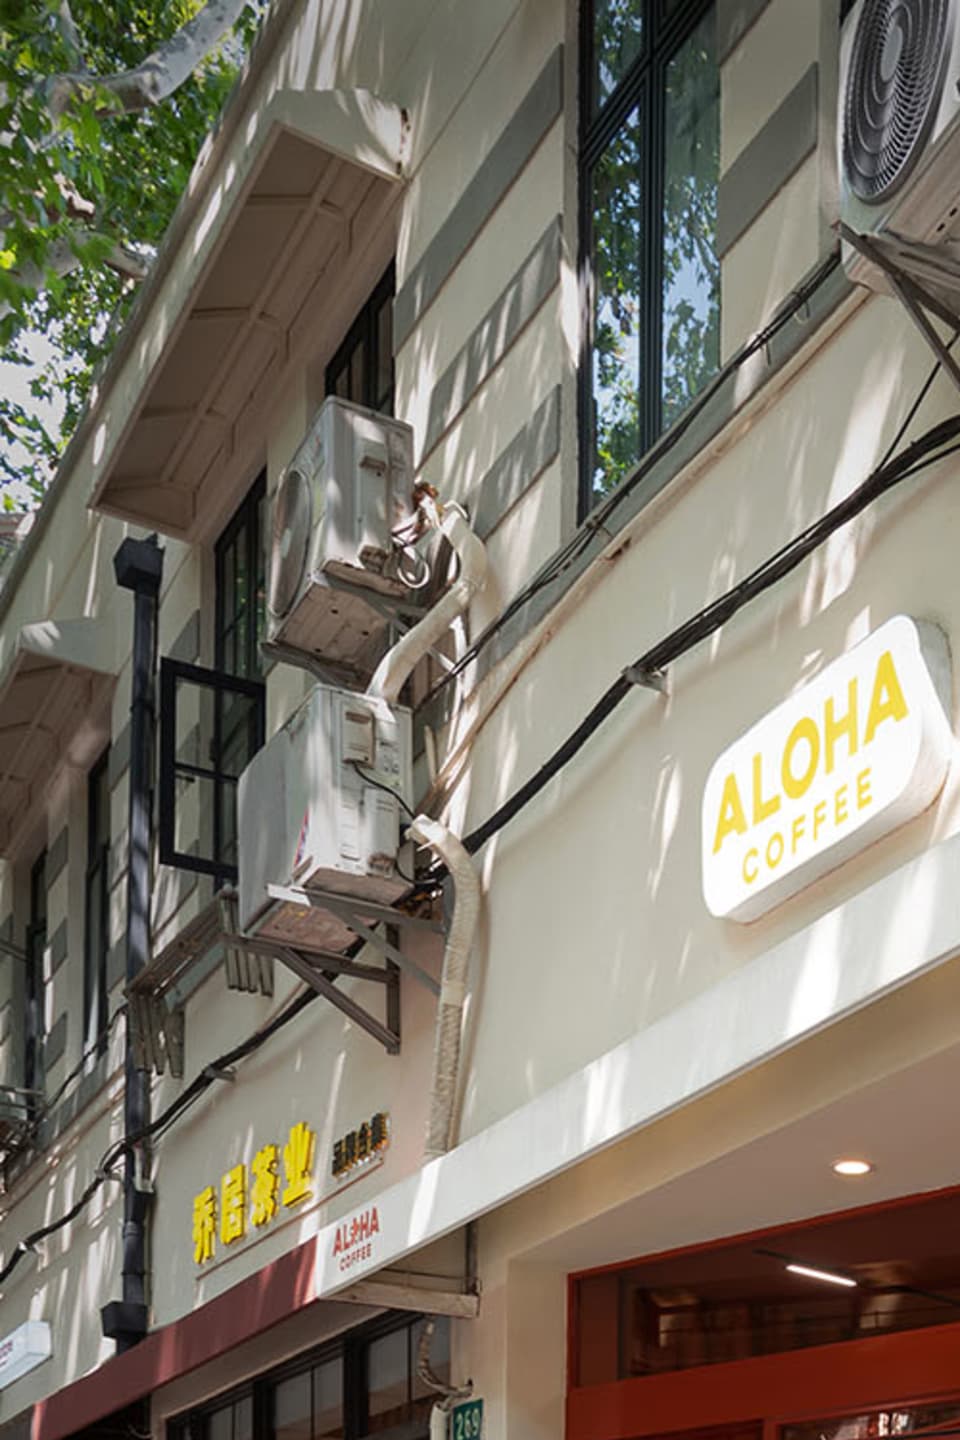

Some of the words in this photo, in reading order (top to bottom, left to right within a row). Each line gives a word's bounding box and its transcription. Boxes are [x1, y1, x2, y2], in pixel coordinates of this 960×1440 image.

[712, 650, 909, 856] ALOHA
[742, 767, 873, 884] COFFEE
[339, 1243, 372, 1271] COFFEE
[456, 1408, 480, 1440] 269
